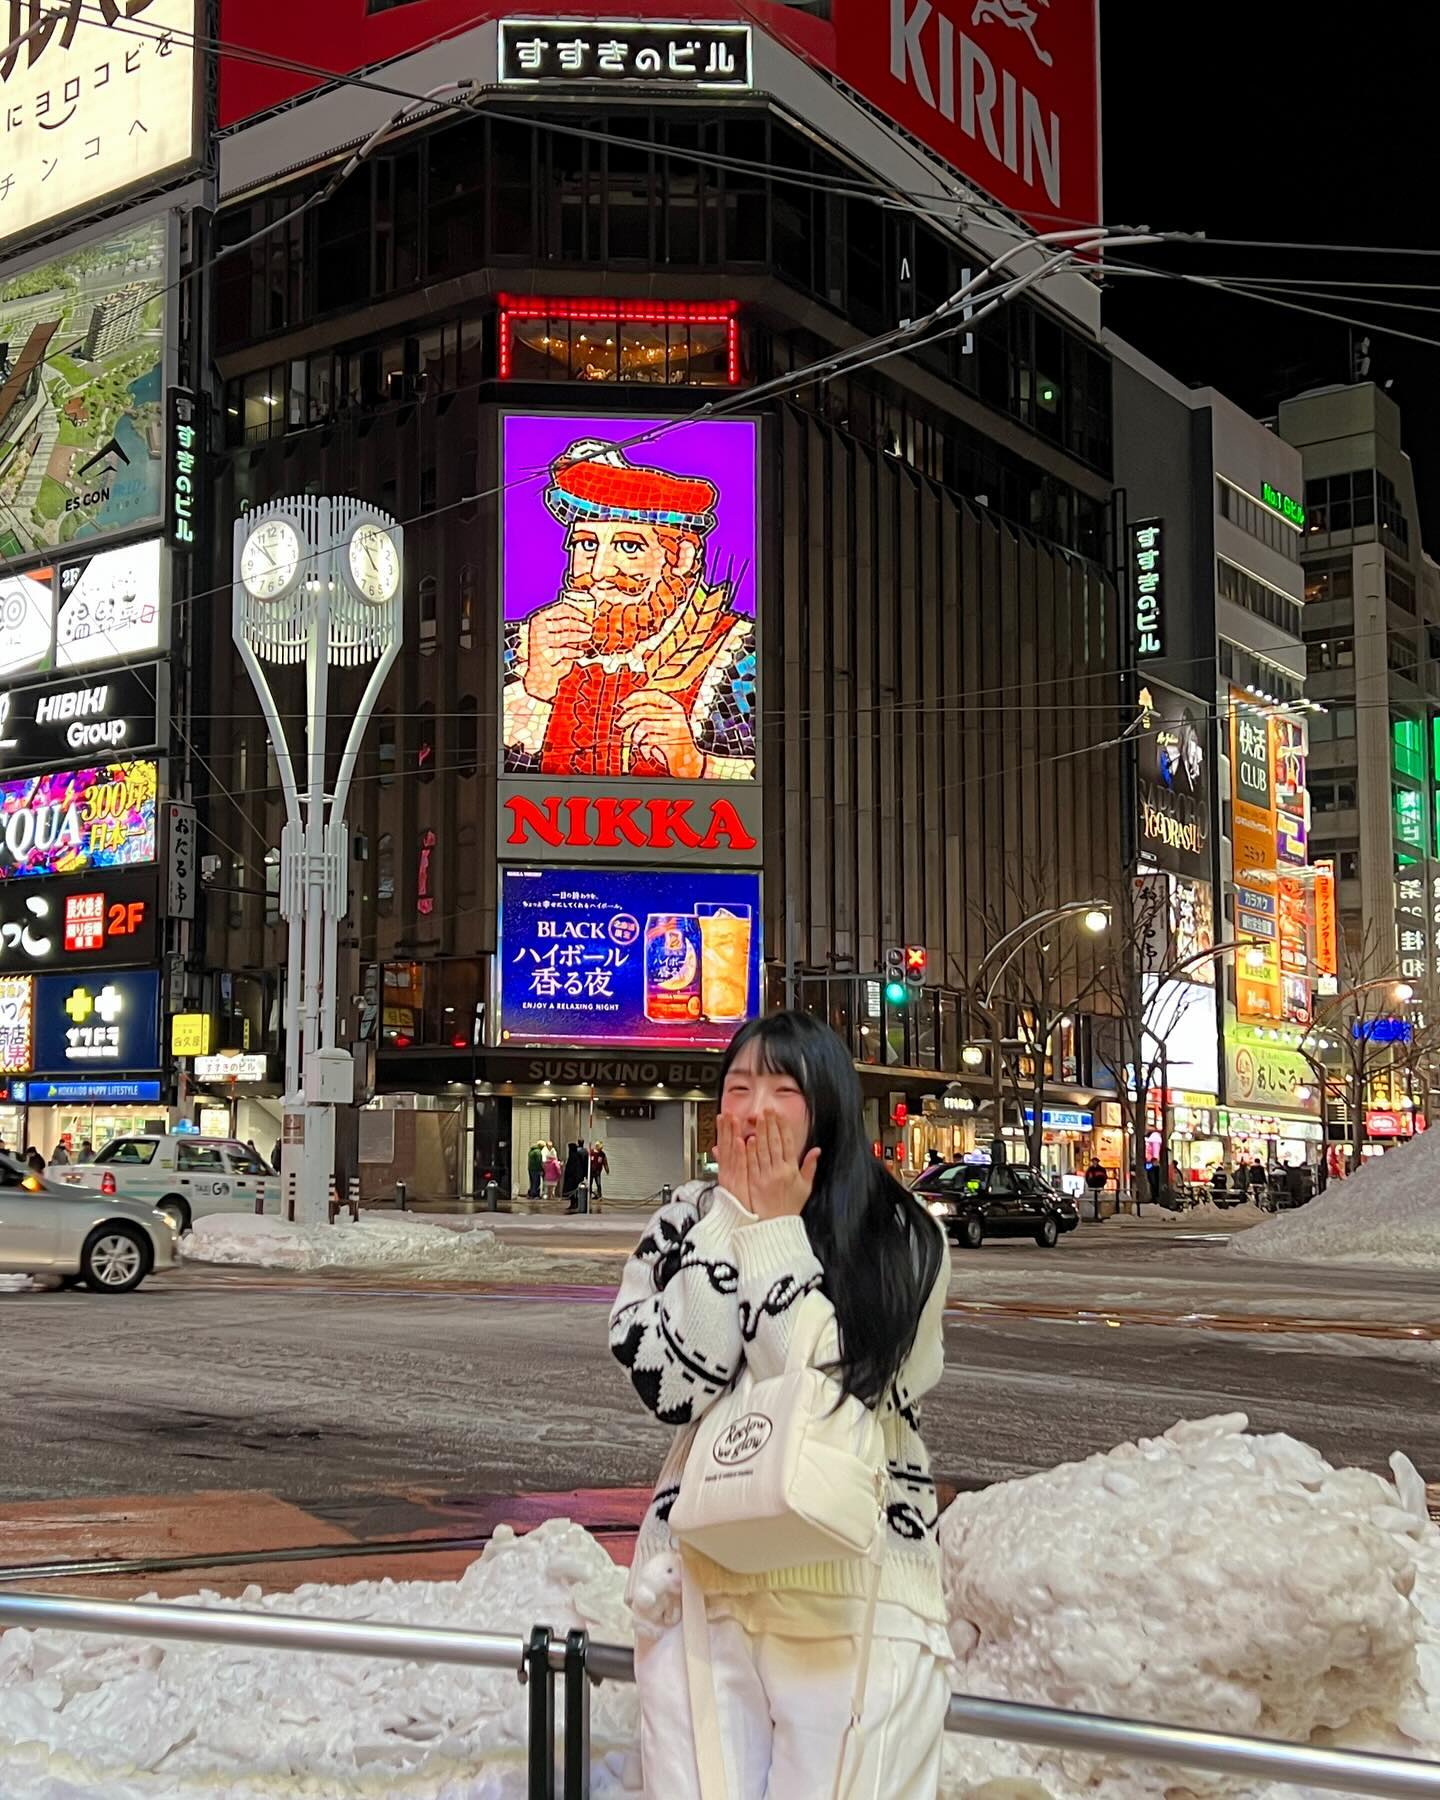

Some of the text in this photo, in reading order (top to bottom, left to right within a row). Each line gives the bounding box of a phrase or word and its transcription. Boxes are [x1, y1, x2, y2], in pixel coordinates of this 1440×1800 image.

[515, 37, 736, 74] すすきのビル
[890, 0, 1061, 208] KIRIN
[176, 397, 196, 542] すすきのビル
[1137, 527, 1160, 652] すすきのビル
[36, 686, 108, 724] HIBIKI
[67, 719, 127, 747] Group
[1240, 720, 1266, 762] 快活
[1240, 761, 1267, 791] CLUB
[81, 779, 149, 822] 300坪
[90, 822, 146, 853] 日本一
[504, 795, 757, 849] NIKKA
[108, 902, 144, 935] 2F
[537, 921, 606, 939] BLACK
[513, 944, 629, 967] ハイボール
[528, 967, 614, 997] 香る夜
[523, 1002, 547, 1010] ENJOY
[528, 1060, 658, 1083] SUSUKINO
